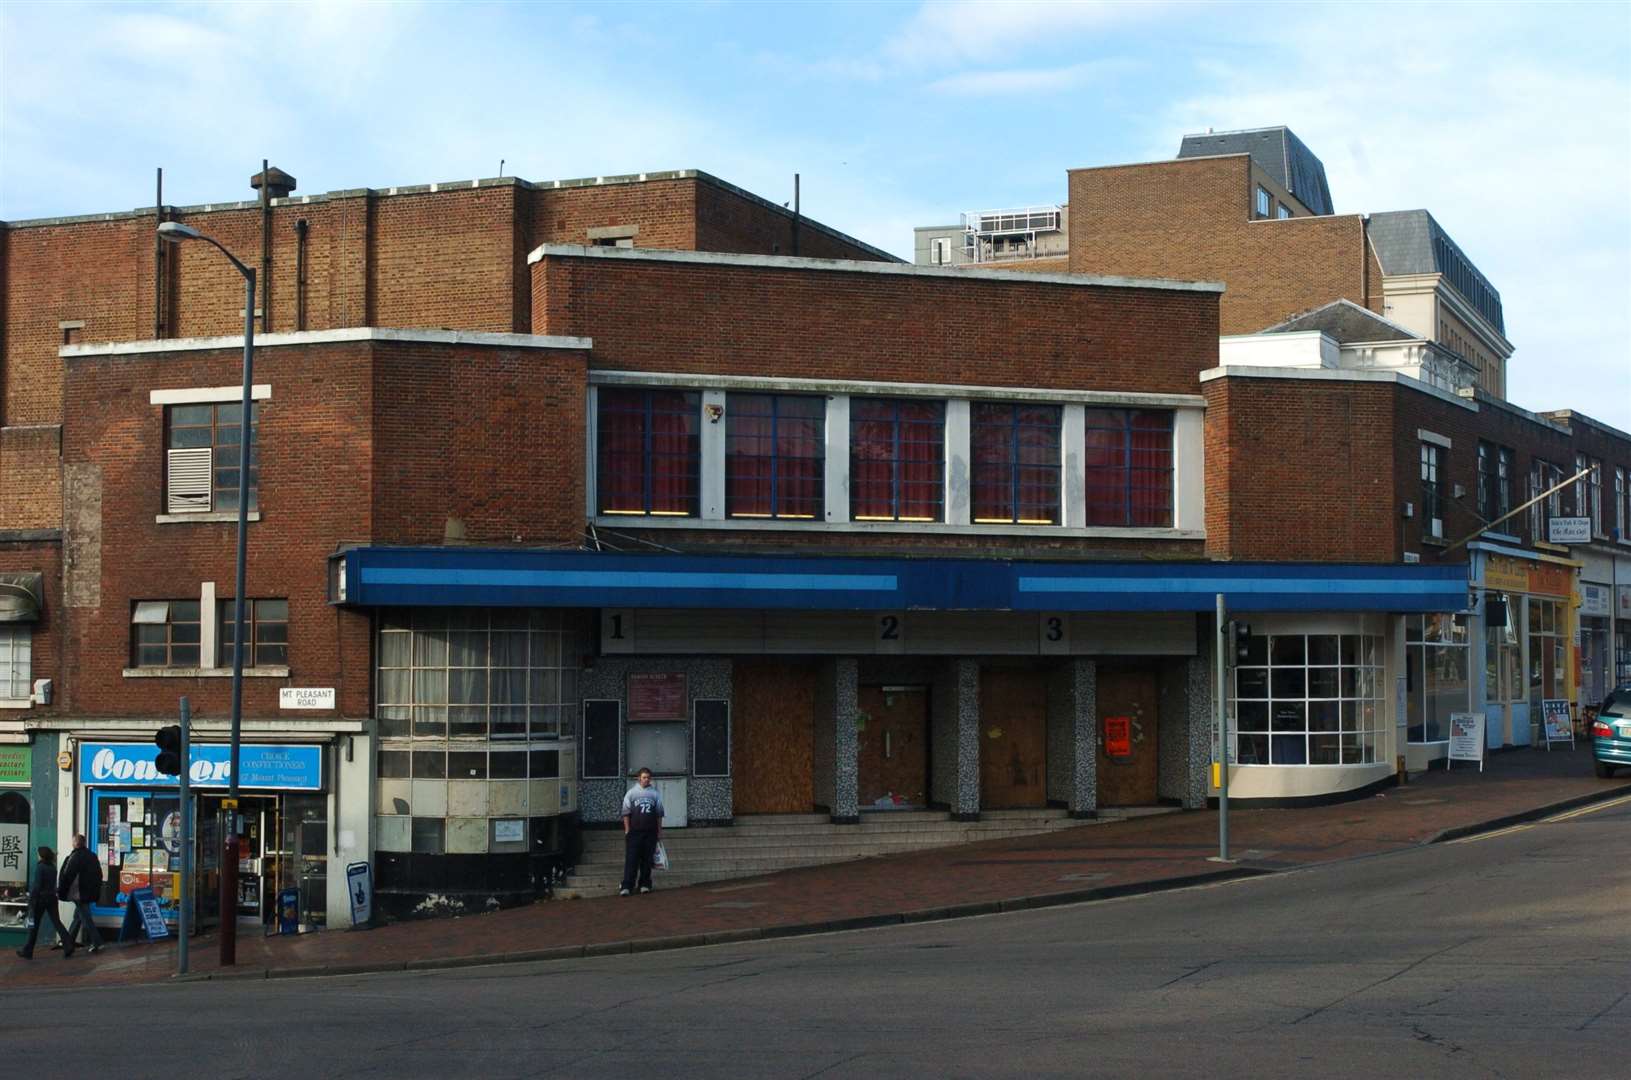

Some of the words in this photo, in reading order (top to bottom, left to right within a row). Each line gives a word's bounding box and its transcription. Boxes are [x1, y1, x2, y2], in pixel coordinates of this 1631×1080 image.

[610, 614, 625, 639] 1
[880, 615, 899, 640] 2
[1047, 616, 1063, 641] 3
[282, 690, 293, 698] MT
[296, 690, 332, 698] PLEASANT
[297, 698, 317, 706] ROAD
[91, 748, 231, 781] Couer
[640, 803, 651, 813] 72
